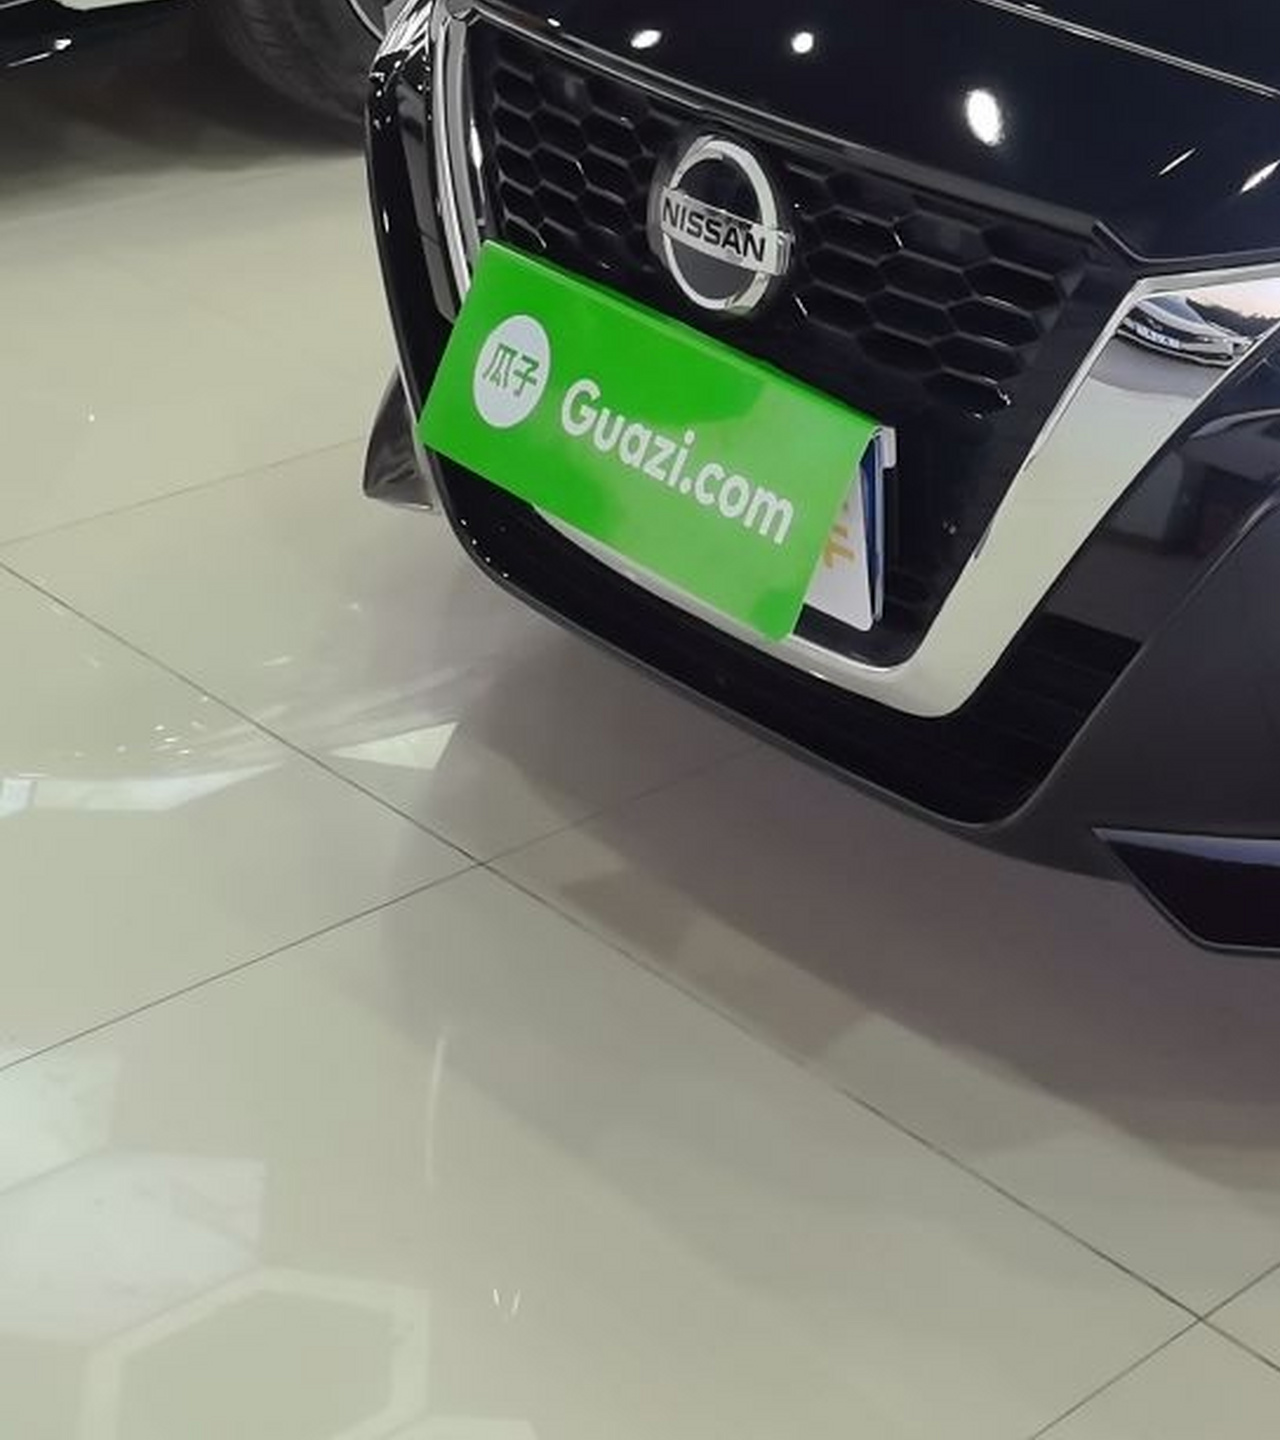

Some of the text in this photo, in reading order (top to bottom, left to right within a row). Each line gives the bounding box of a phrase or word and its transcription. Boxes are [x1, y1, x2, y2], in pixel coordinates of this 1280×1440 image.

[662, 197, 766, 263] NISSAN
[482, 342, 540, 397] 瓜子
[561, 378, 795, 545] Guazi.com
